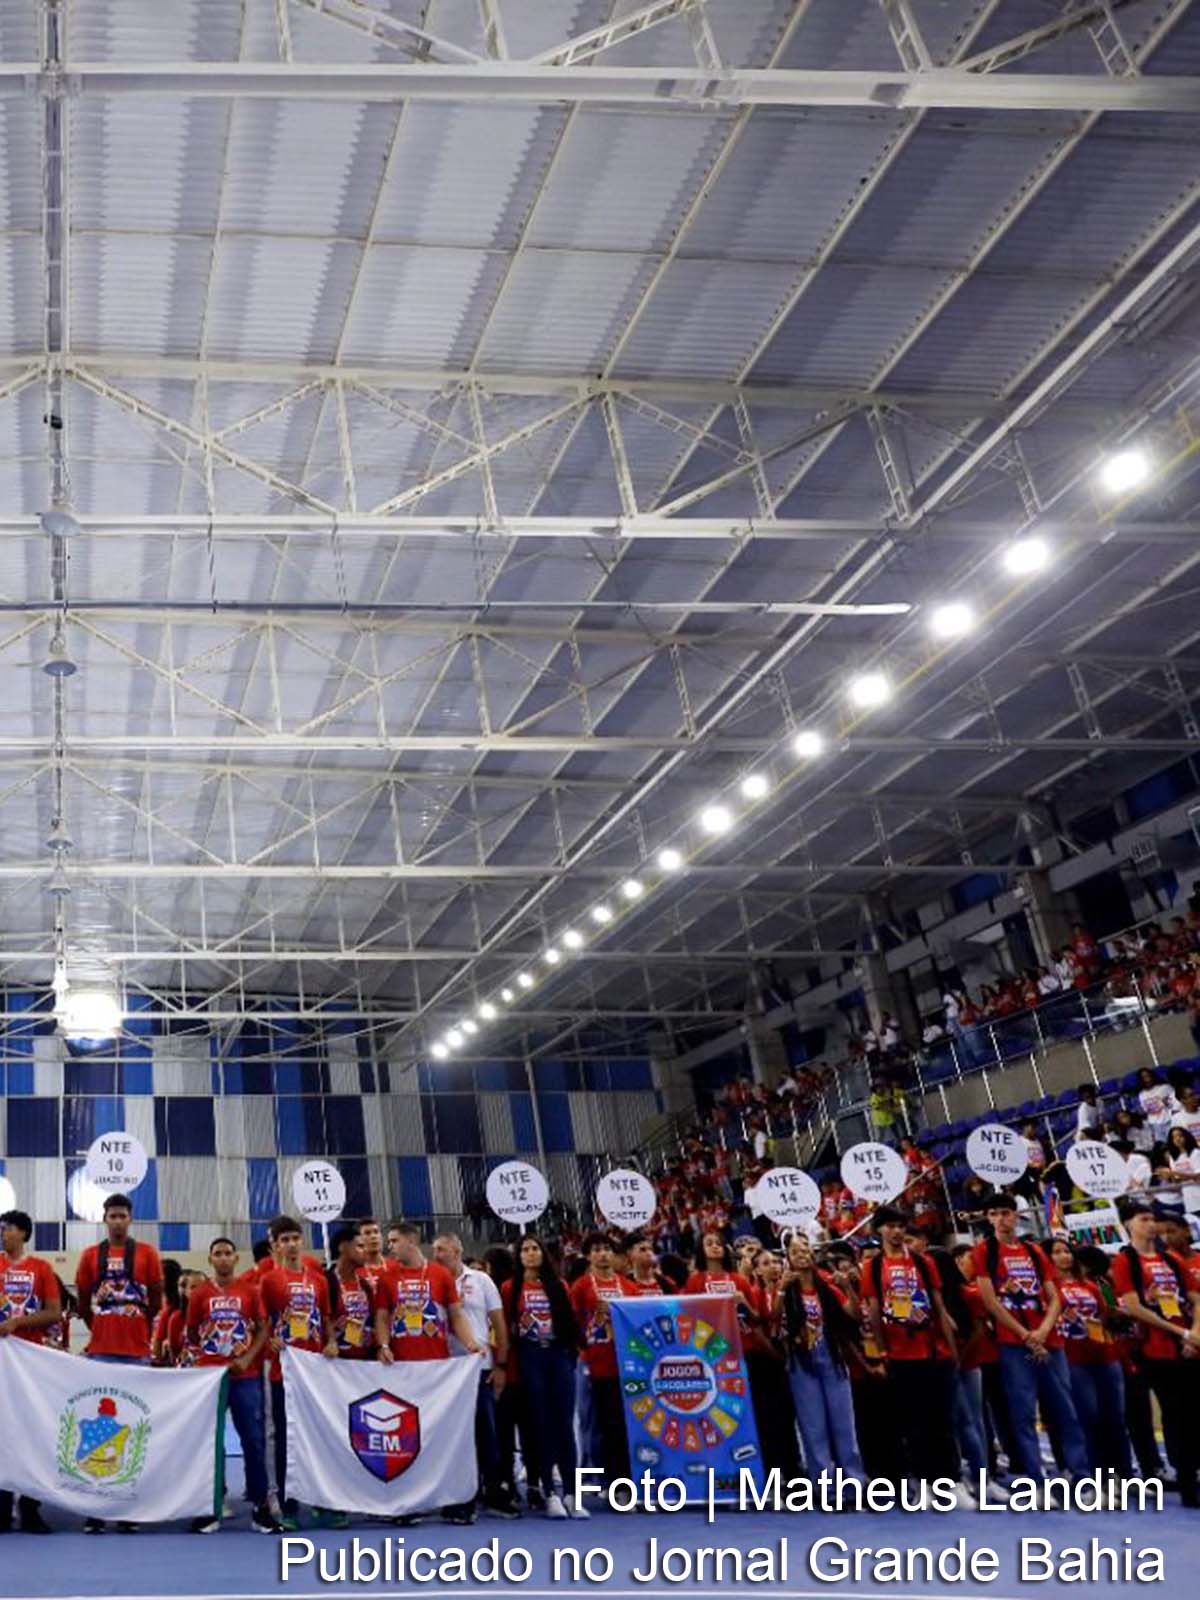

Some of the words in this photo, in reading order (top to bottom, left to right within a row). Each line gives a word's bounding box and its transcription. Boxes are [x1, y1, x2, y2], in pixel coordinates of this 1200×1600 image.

[981, 1131, 1013, 1144] NTE
[101, 1141, 131, 1154] NTE
[1075, 1147, 1107, 1160] NTE
[853, 1150, 886, 1164] NTE
[990, 1150, 1006, 1162] 16
[108, 1160, 123, 1172] 10
[1089, 1164, 1105, 1176] 17
[304, 1170, 331, 1183] NTE
[500, 1170, 530, 1185] NTE
[865, 1168, 882, 1180] 15
[610, 1179, 640, 1191] NTE
[768, 1174, 800, 1188] NTE
[315, 1188, 328, 1200] 11
[510, 1189, 526, 1200] 12
[780, 1192, 797, 1204] 14
[620, 1196, 635, 1207] 13
[368, 1433, 401, 1452] EM
